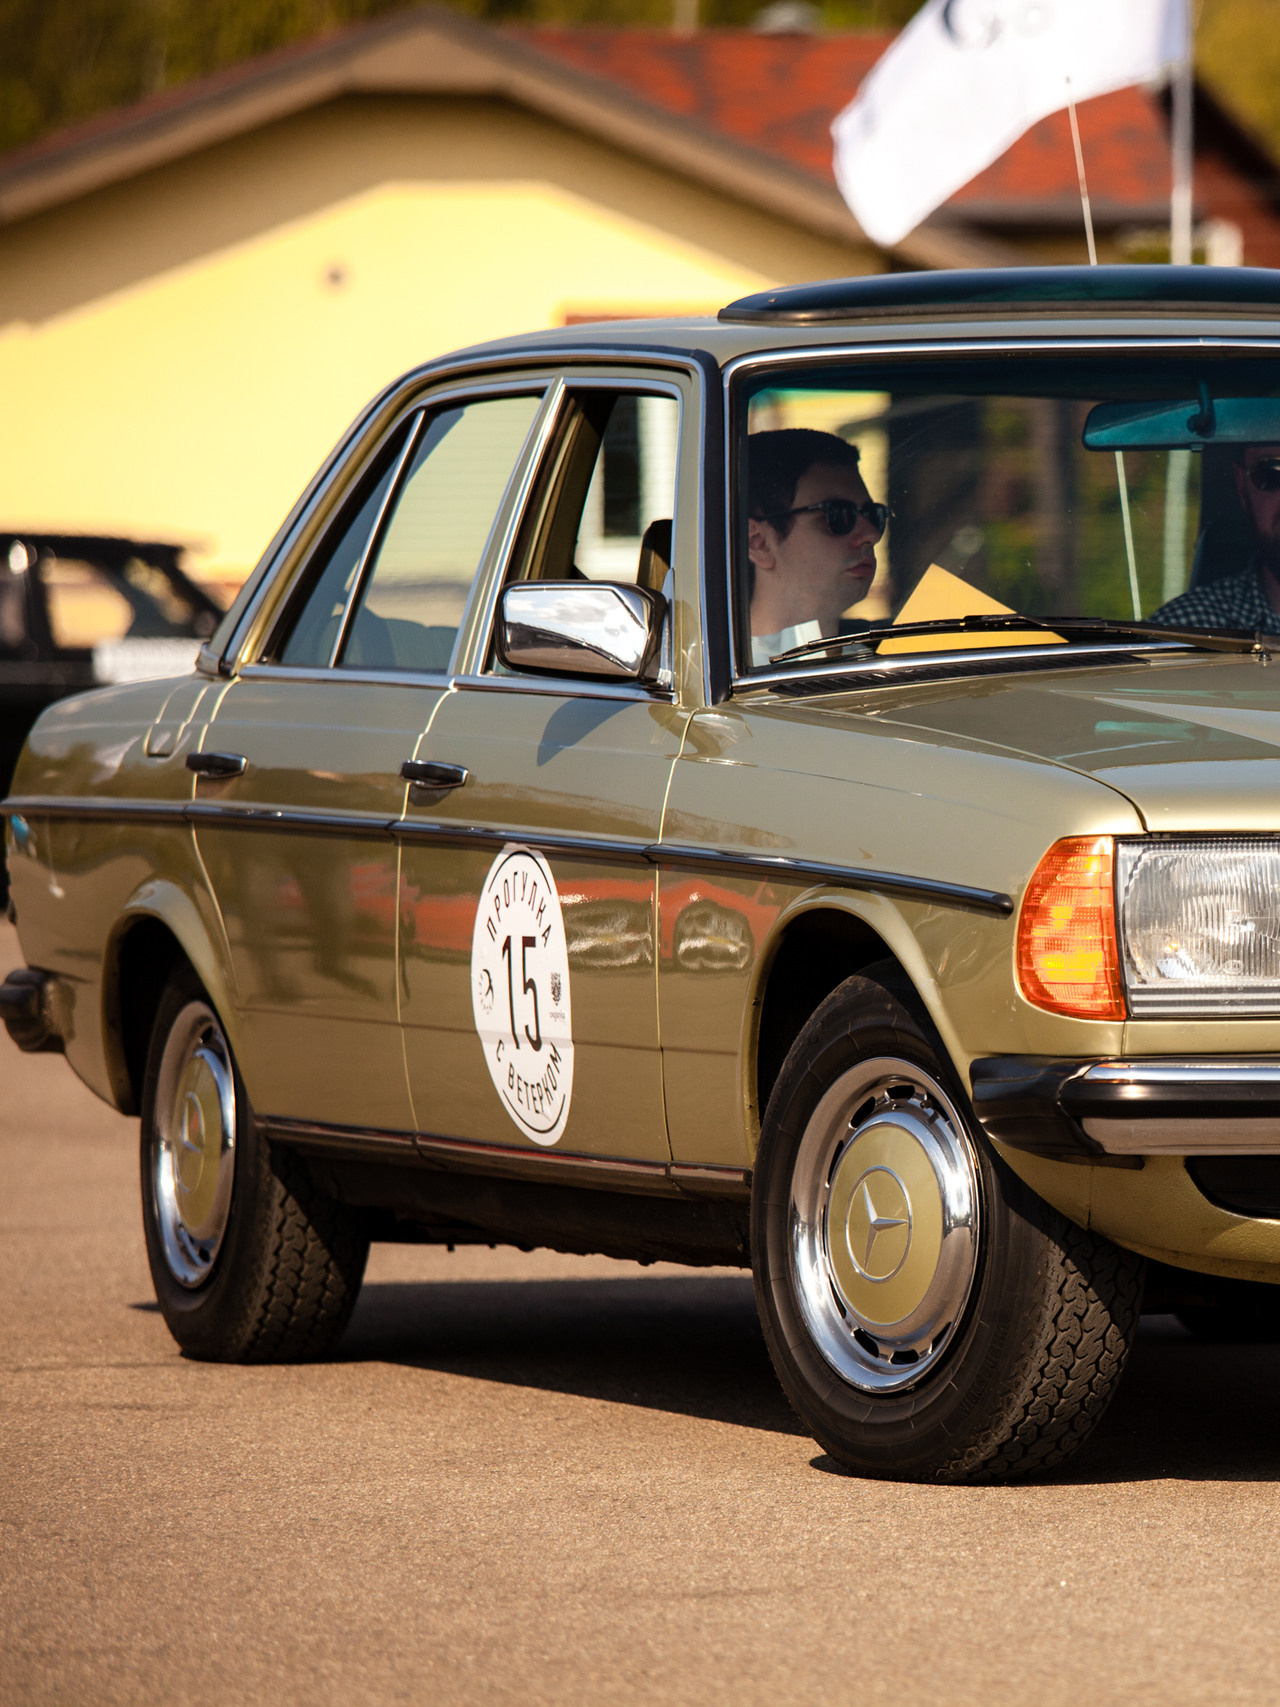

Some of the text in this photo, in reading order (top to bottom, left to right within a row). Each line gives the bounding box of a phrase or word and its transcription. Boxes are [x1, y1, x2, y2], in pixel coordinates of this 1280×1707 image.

[486, 870, 552, 948] ПРОГУЛКА
[502, 935, 542, 1052] 15
[496, 1039, 562, 1114] С ВЕТЕРКОМ
